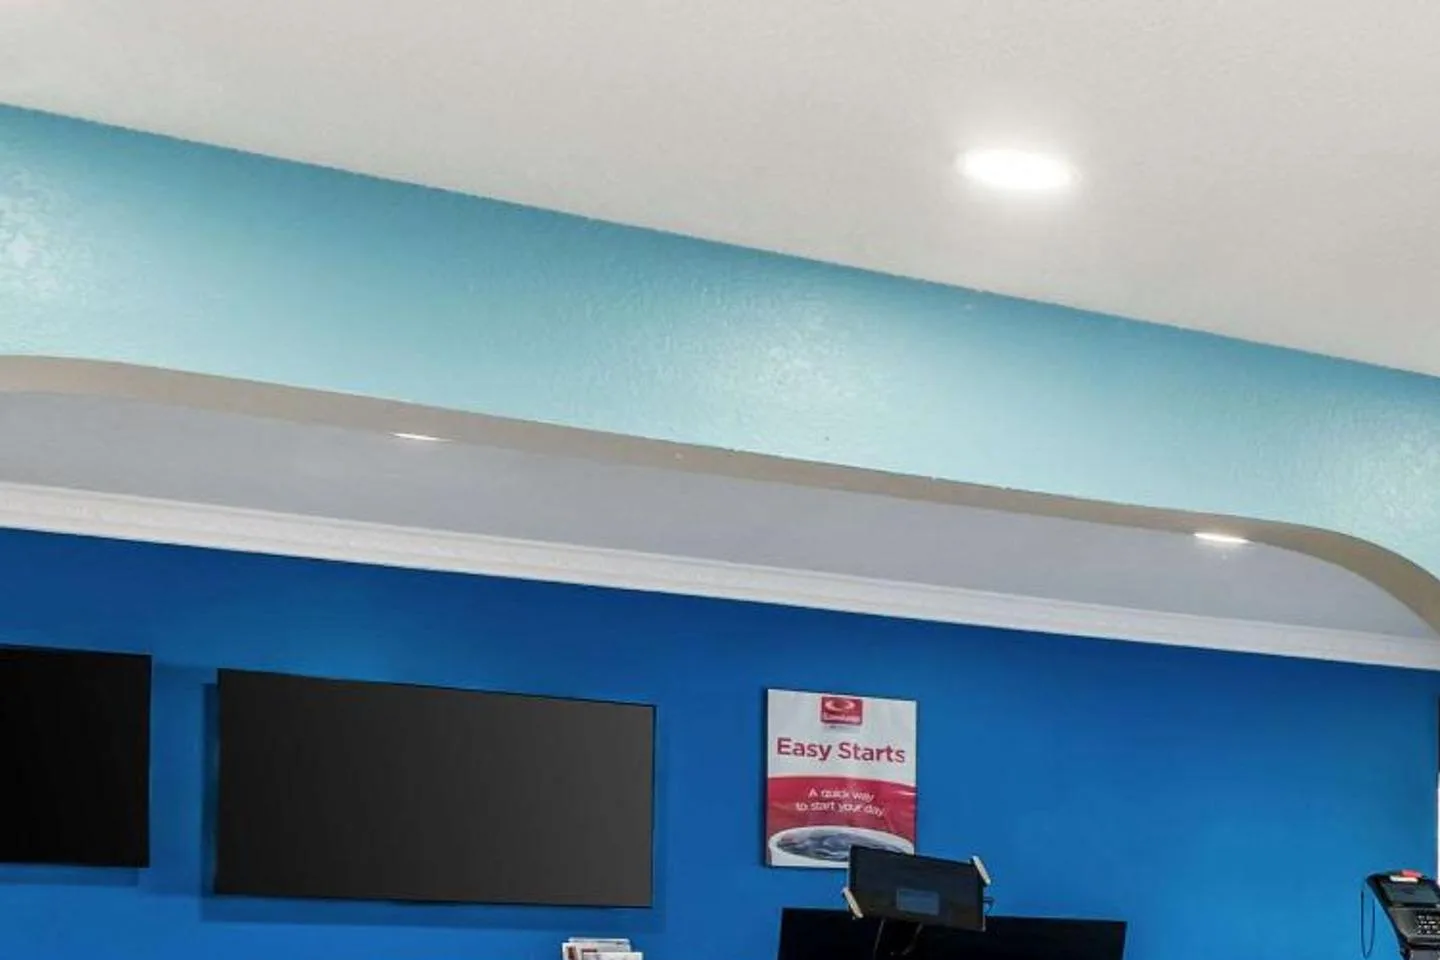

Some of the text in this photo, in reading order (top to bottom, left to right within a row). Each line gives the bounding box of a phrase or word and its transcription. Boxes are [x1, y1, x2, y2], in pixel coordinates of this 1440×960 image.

[777, 737, 906, 763] Easy Starts
[808, 788, 875, 803] A quick way
[795, 802, 885, 817] to start your day
